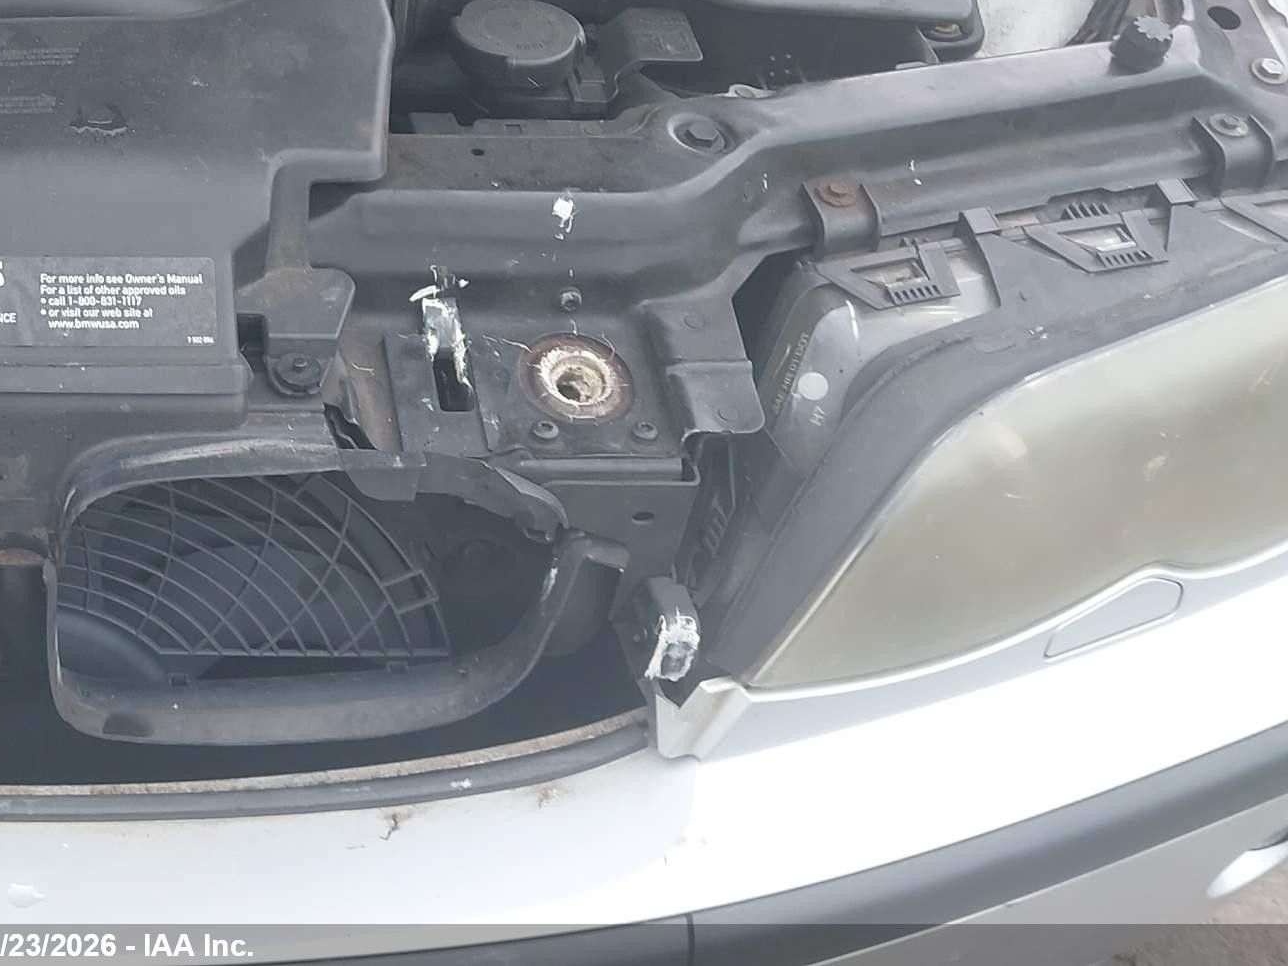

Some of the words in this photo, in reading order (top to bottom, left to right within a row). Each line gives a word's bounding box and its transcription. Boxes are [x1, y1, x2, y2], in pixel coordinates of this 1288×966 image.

[40, 274, 57, 284] For
[58, 275, 85, 284] more
[86, 274, 105, 284] info
[105, 275, 124, 284] see
[125, 274, 165, 284] Owner's
[166, 274, 203, 284] Manual
[40, 285, 57, 295] For
[58, 287, 66, 295] a
[67, 285, 82, 295] list
[83, 285, 93, 295] of
[94, 285, 121, 295] other
[122, 285, 167, 297] approved
[168, 285, 187, 295] oils
[48, 296, 67, 306] call
[68, 296, 142, 306] 1-800-831-1117
[48, 309, 60, 317] or
[61, 307, 81, 317] visit
[82, 309, 100, 317] our
[101, 307, 122, 317] web
[123, 307, 142, 317] site
[143, 307, 153, 317] at
[48, 318, 140, 329] www.bmwusa.com
[810, 405, 825, 426] H7
